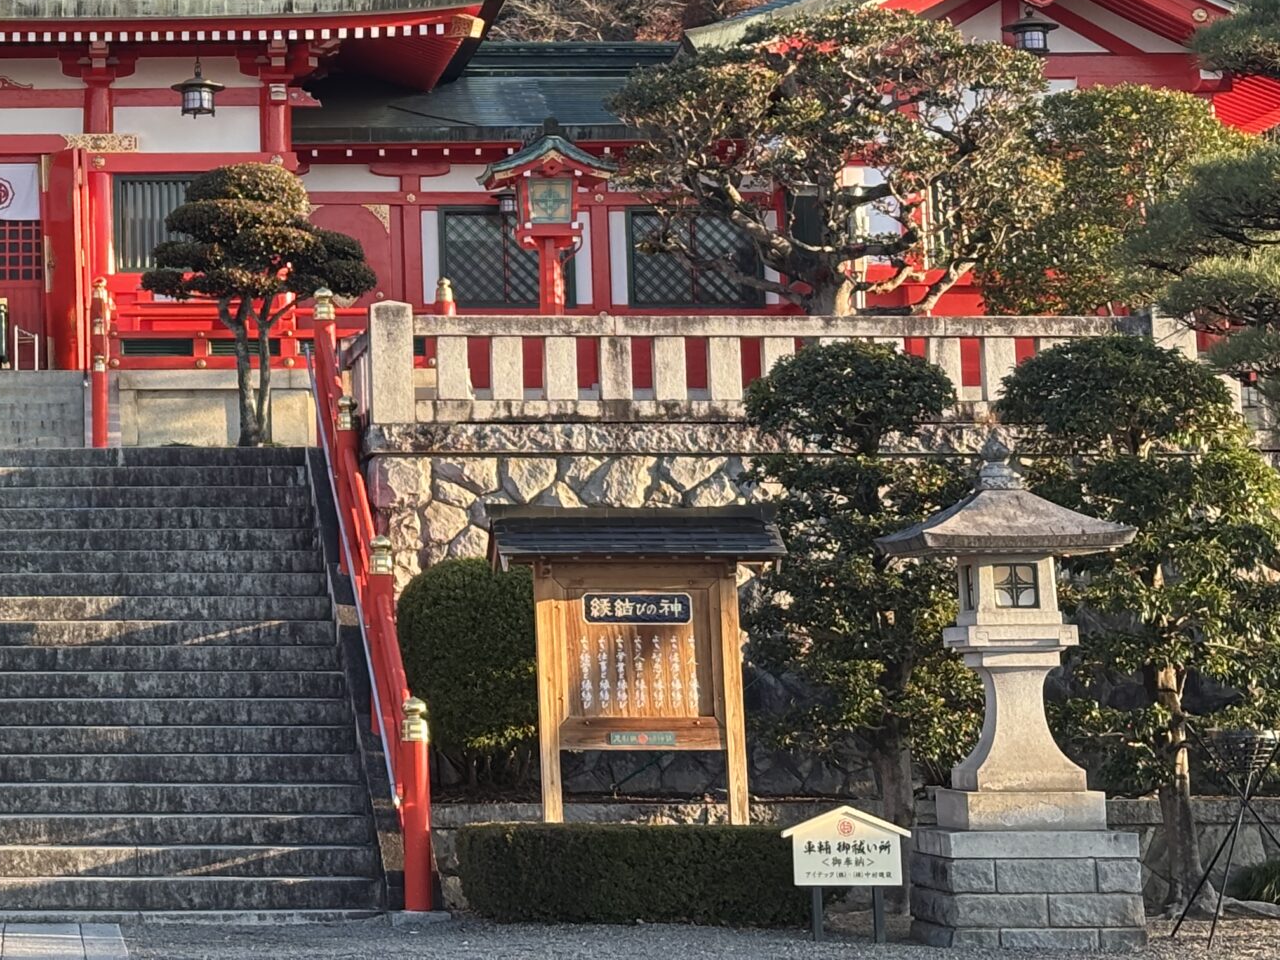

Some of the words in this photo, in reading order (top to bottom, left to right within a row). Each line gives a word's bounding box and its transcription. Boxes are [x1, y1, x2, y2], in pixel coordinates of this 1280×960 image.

[590, 597, 683, 618] 縁結びの神
